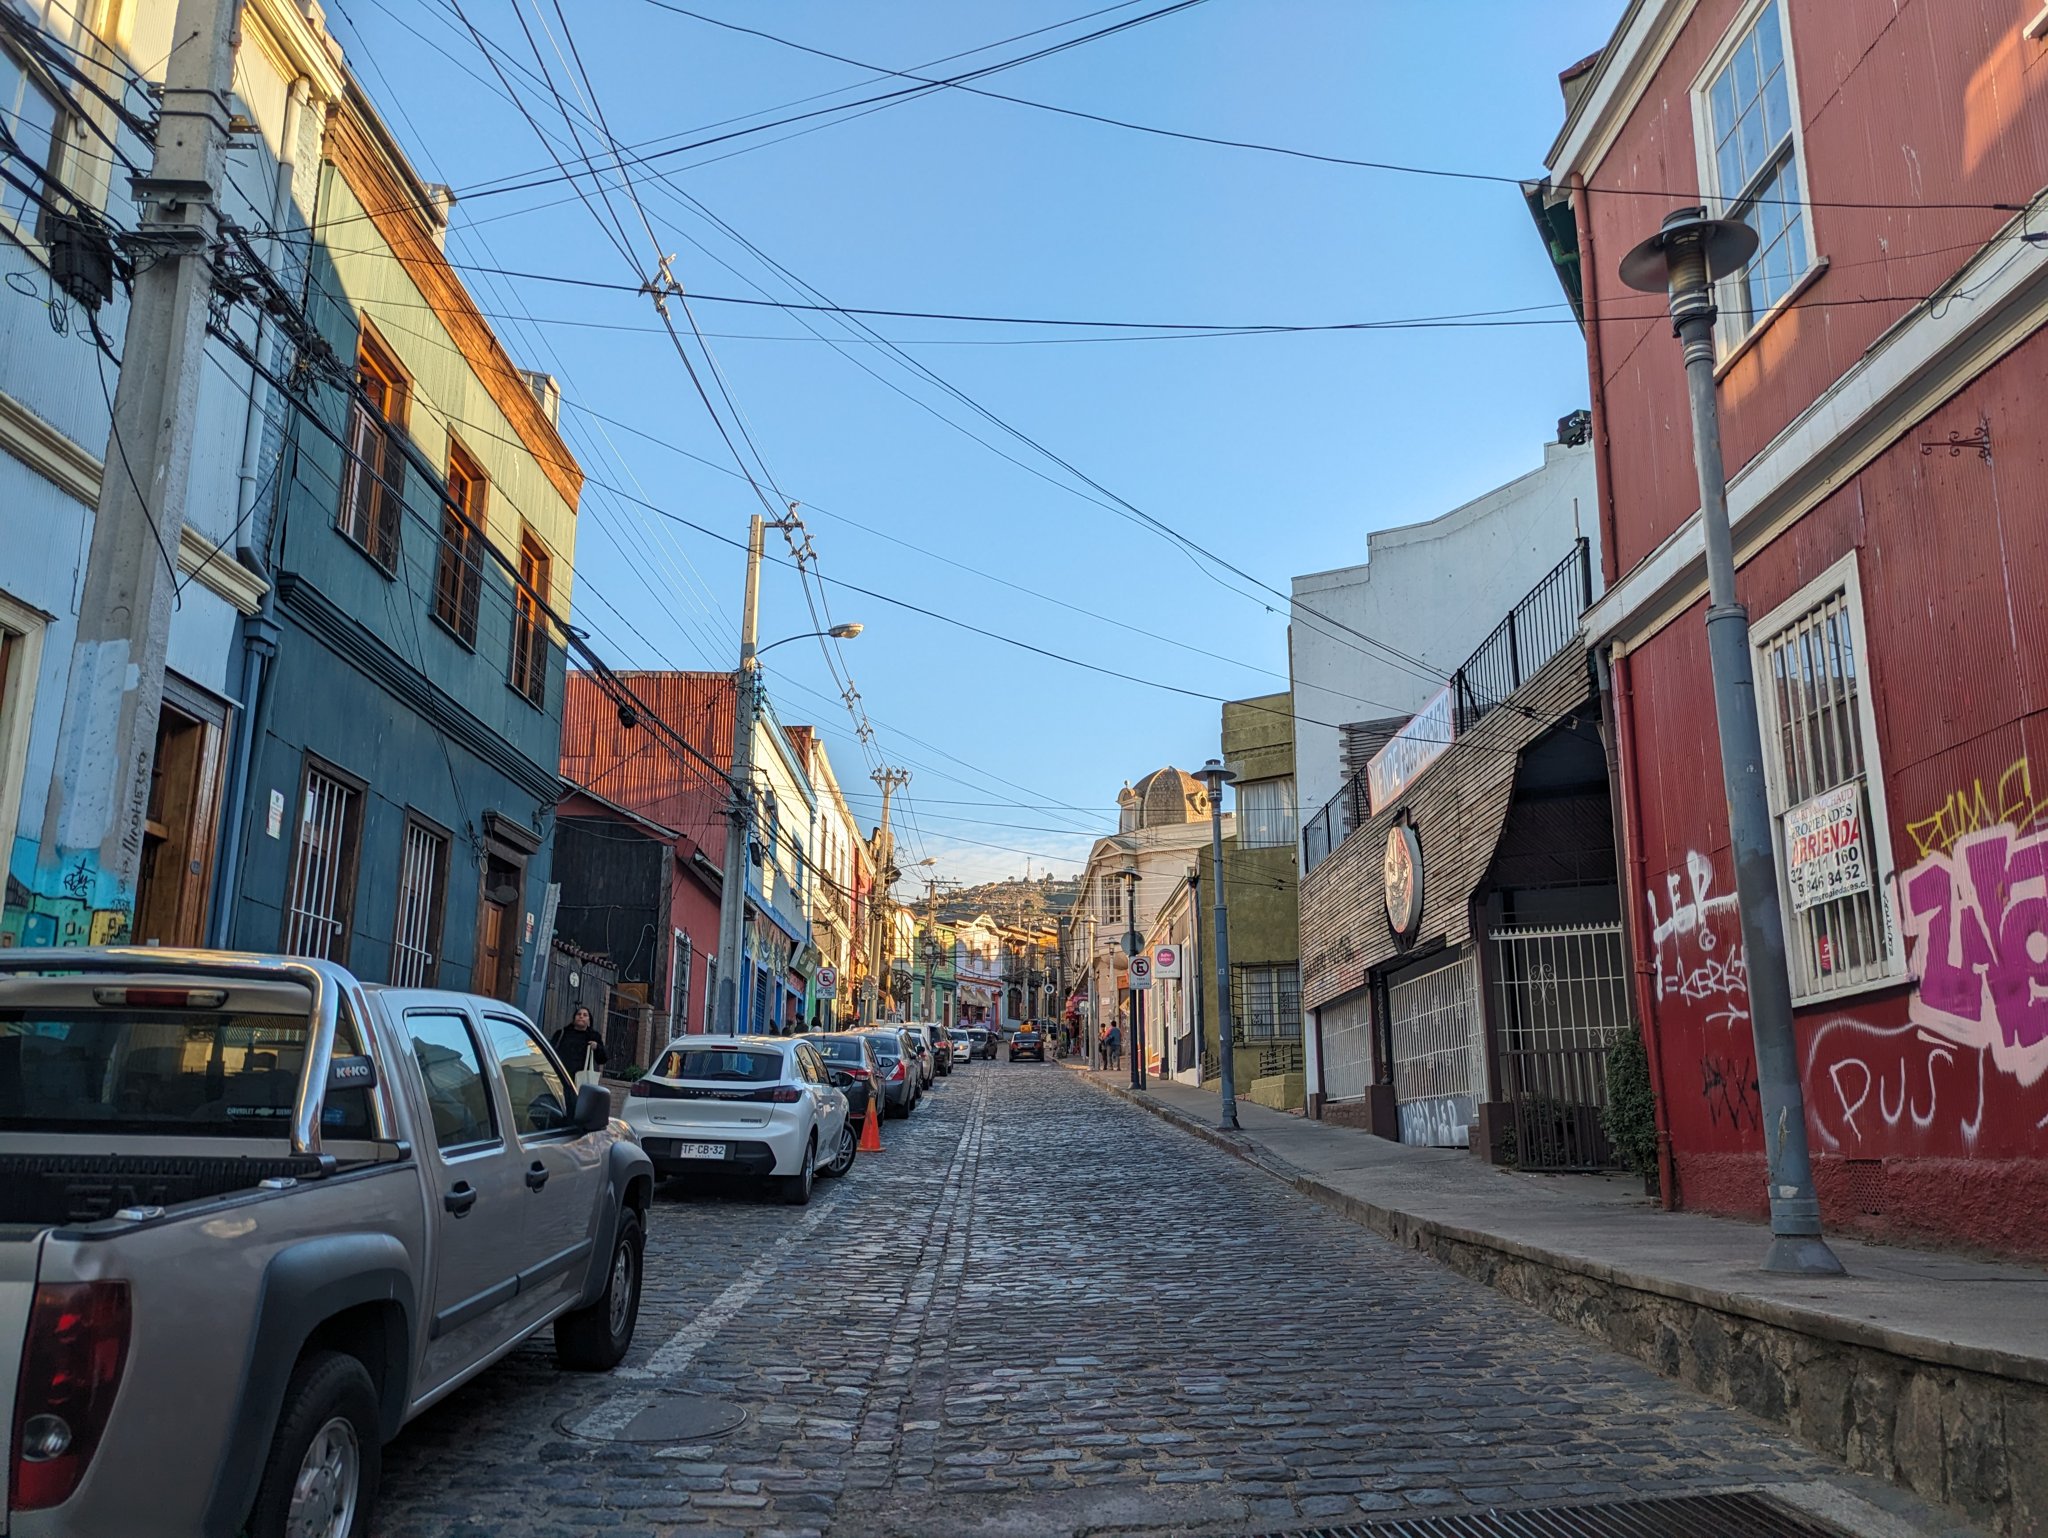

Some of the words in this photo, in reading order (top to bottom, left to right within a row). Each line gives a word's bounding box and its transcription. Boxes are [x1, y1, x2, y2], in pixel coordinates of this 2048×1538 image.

[1791, 803, 1853, 840] PROPIEDADES
[1791, 817, 1859, 868] ARRIENDA
[1791, 867, 1802, 883] 32
[1809, 856, 1829, 876] 211
[1834, 846, 1858, 867] 160
[1798, 883, 1804, 897] 9
[1828, 869, 1842, 886] 84
[1845, 863, 1860, 880] 52
